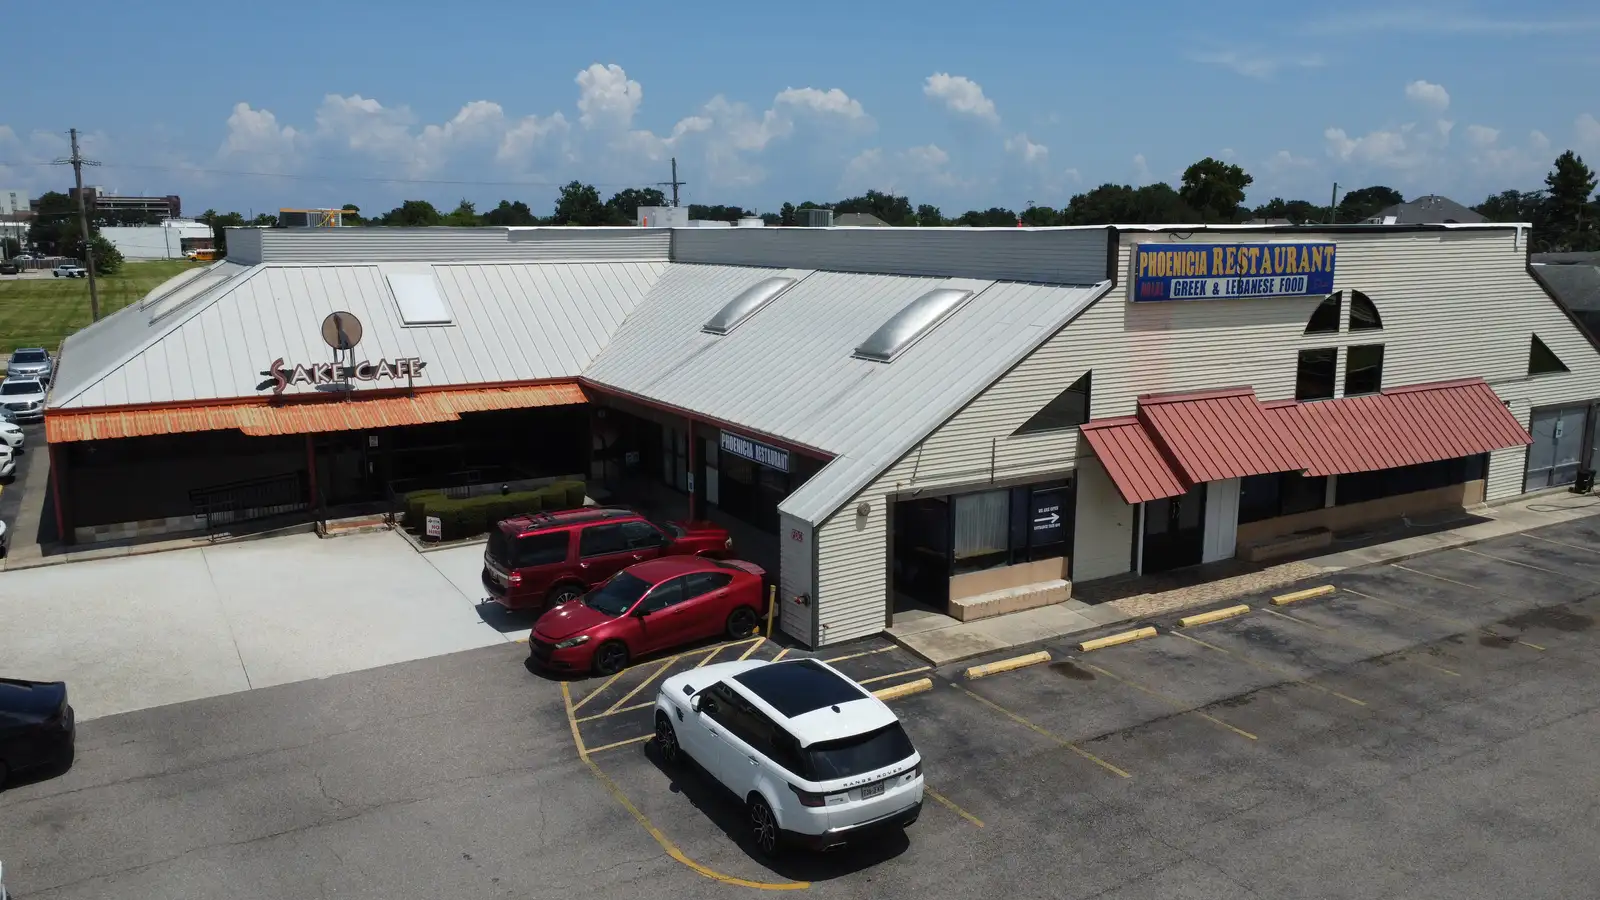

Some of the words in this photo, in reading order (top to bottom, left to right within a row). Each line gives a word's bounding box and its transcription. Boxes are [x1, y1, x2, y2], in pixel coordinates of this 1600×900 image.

[1139, 250, 1208, 277] PHOENICIA
[1211, 246, 1334, 276] RESTAURANT
[1173, 280, 1207, 297] GREEK
[1212, 282, 1220, 296] &
[1225, 277, 1274, 295] LEBANESE
[1279, 275, 1304, 292] FOOD
[270, 357, 345, 395] SAKE
[355, 357, 422, 382] CAFE
[721, 433, 754, 459] PHOENICIA
[755, 444, 788, 471] RESTAURANT
[842, 777, 872, 788] RANGE
[877, 767, 904, 779] ROVER
